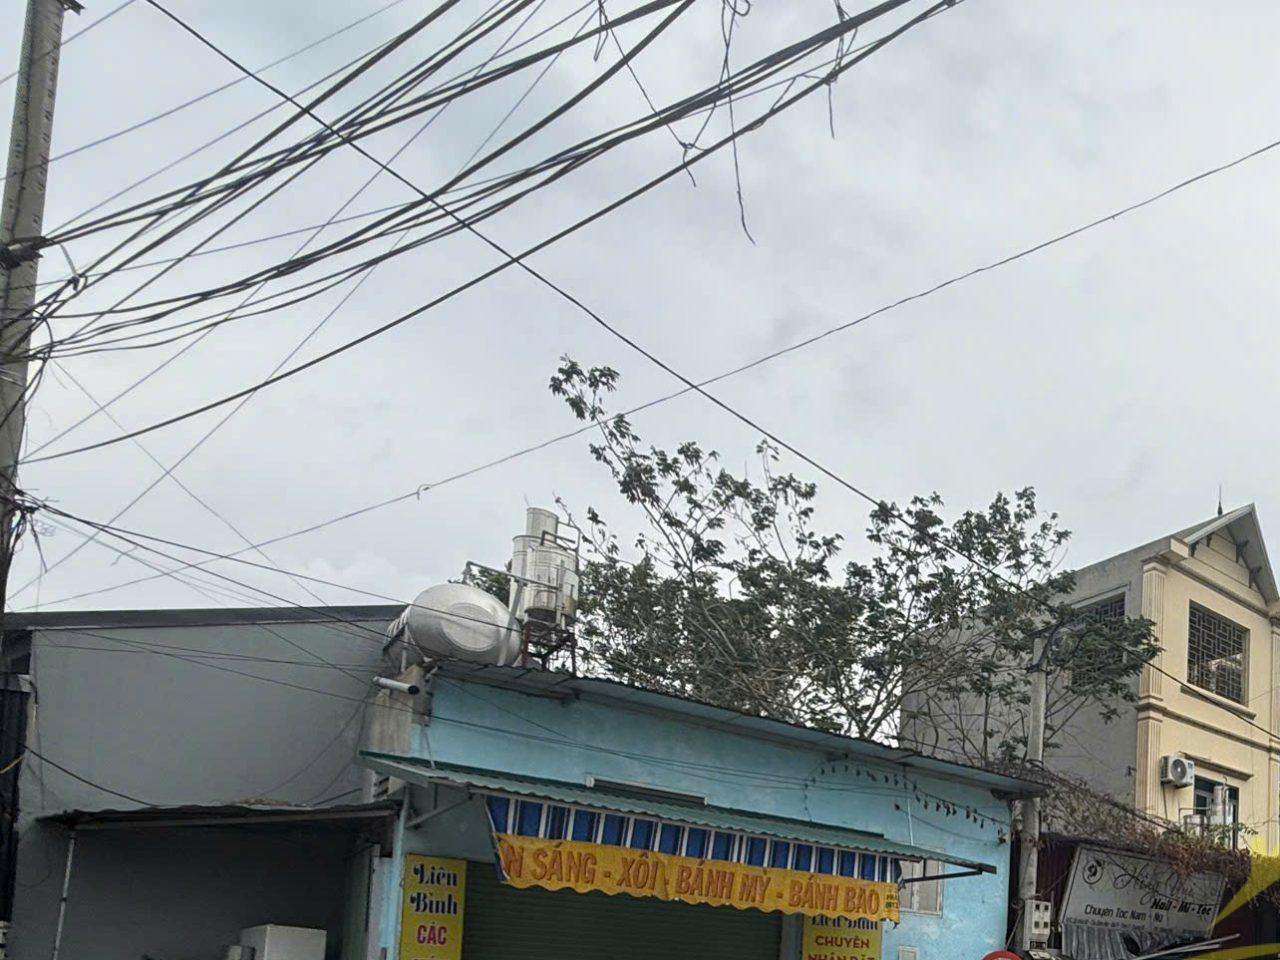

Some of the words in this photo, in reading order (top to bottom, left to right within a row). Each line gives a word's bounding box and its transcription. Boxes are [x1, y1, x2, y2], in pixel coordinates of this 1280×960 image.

[413, 863, 457, 887] Liên
[531, 841, 598, 884] SÁNG
[617, 851, 659, 891] XÔI
[674, 860, 735, 899] BÁNH
[788, 874, 839, 912] BÁNH
[843, 884, 880, 915] BAO
[409, 891, 458, 916] Bình
[416, 920, 448, 945] CÁC
[815, 935, 870, 949] CHUYÊN
